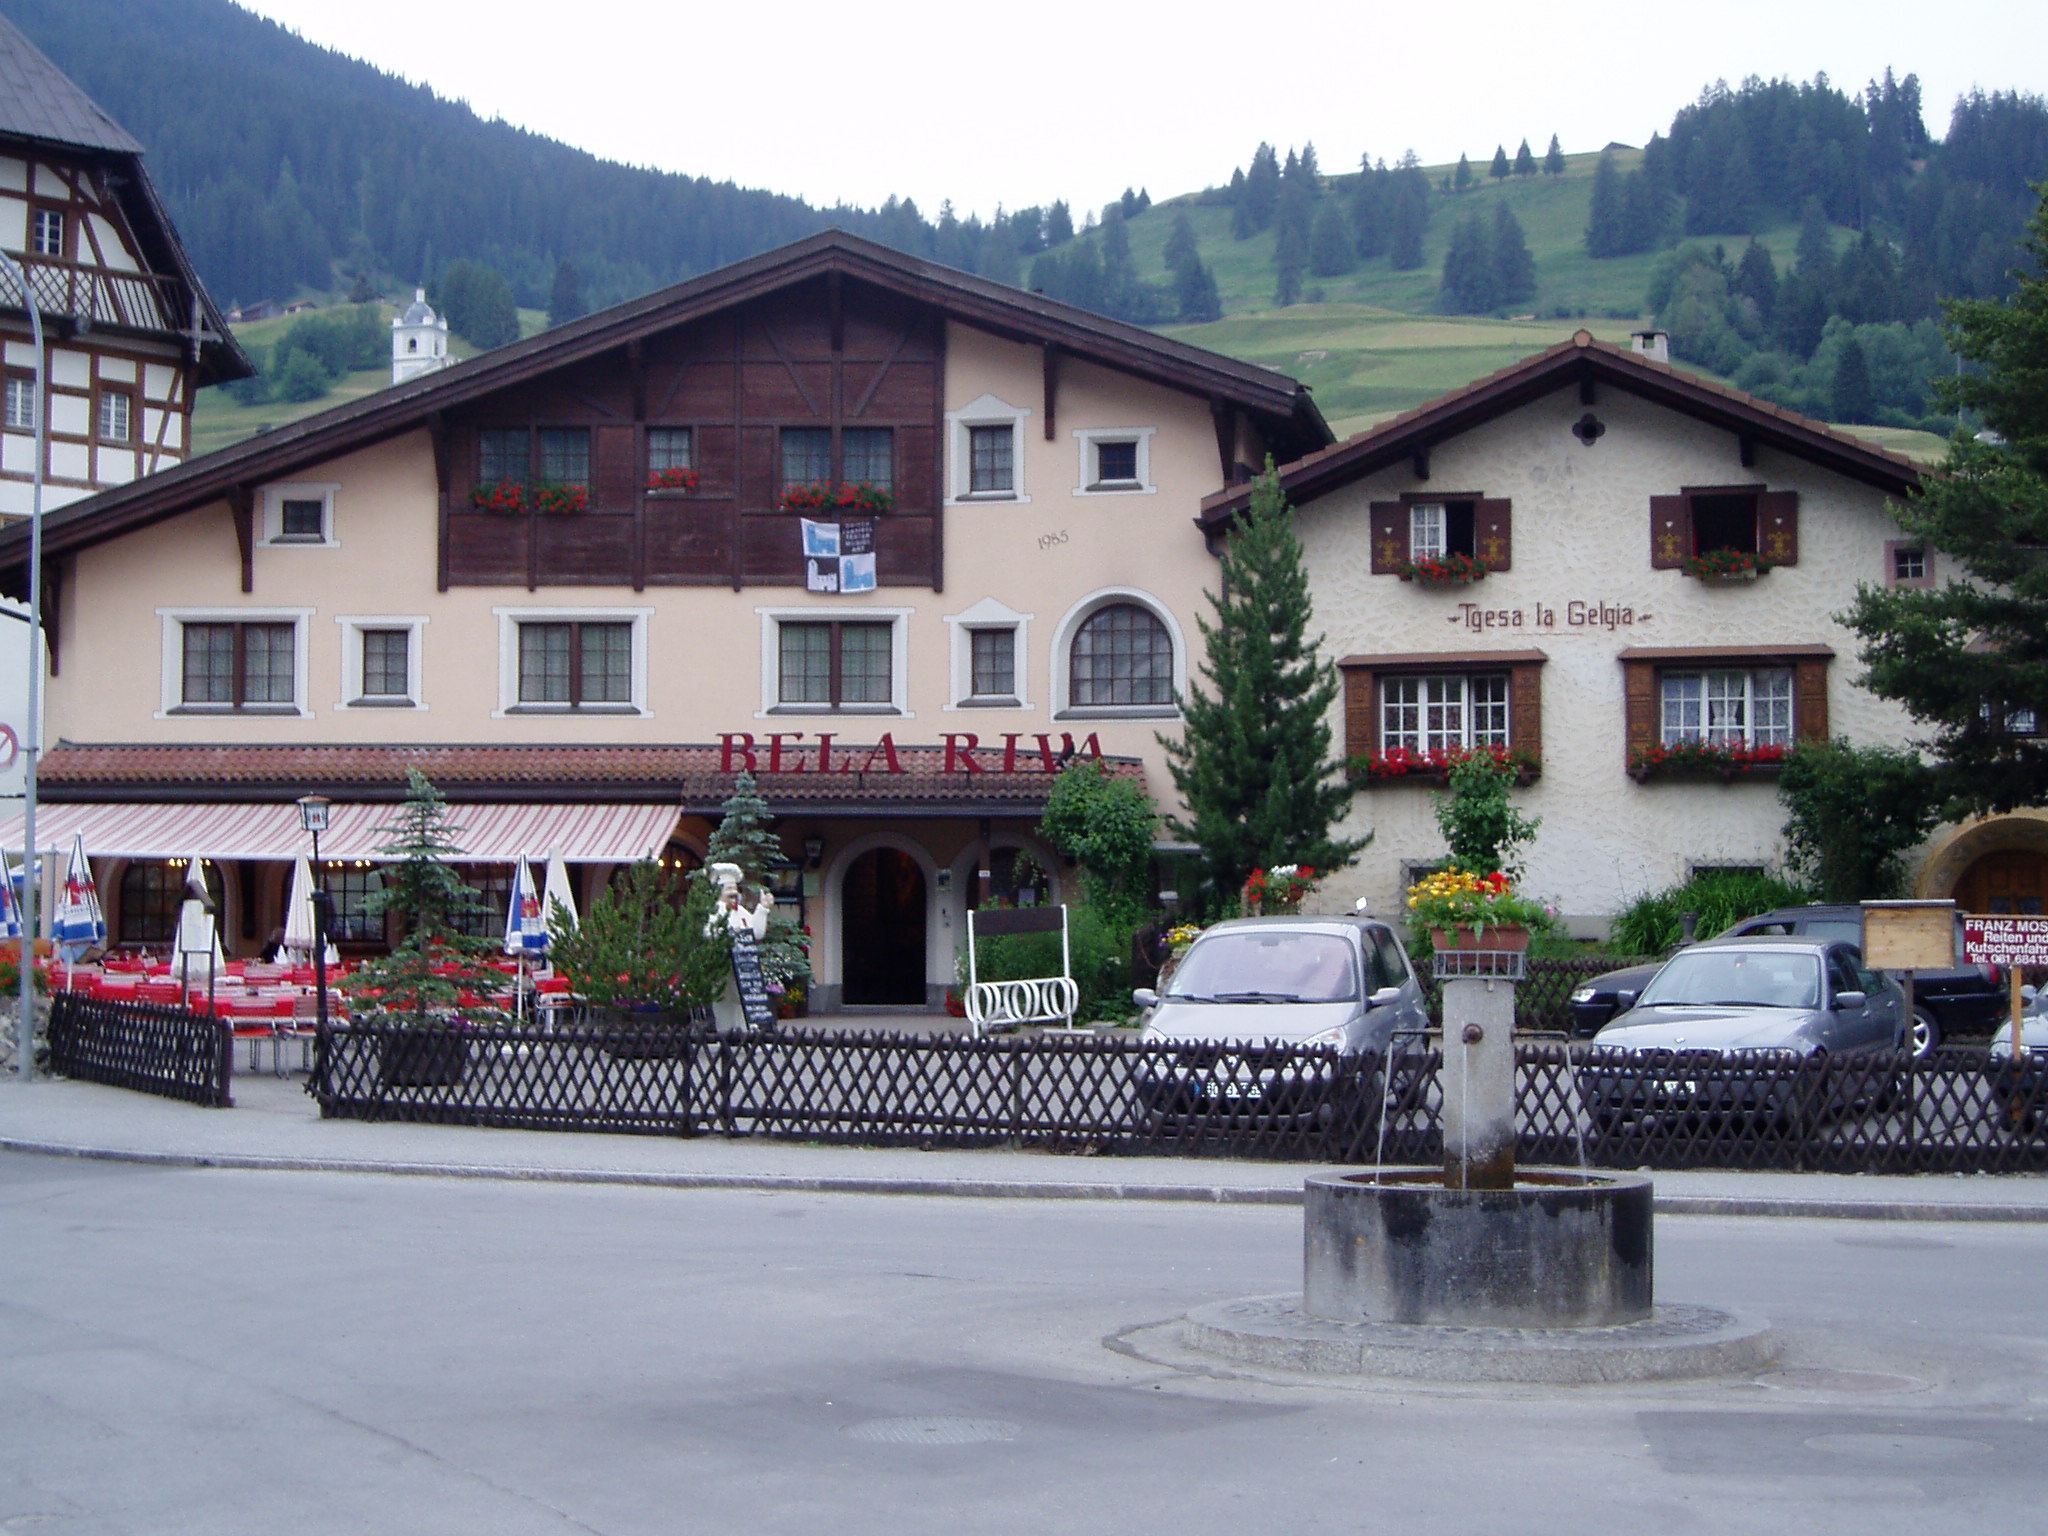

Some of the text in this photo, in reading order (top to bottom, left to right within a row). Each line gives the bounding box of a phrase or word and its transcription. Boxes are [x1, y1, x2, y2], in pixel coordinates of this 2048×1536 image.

[1037, 529, 1069, 550] 1985
[1459, 600, 1633, 632] Tgesa la Gelgia
[716, 732, 1108, 774] BELA RIVA
[1965, 919, 2048, 932] FRANZ MOS
[1984, 931, 2023, 943] Reiten
[1966, 941, 2048, 954] Kutschenfahr
[1971, 953, 1989, 963] Tel.
[1990, 954, 2010, 964] 081
